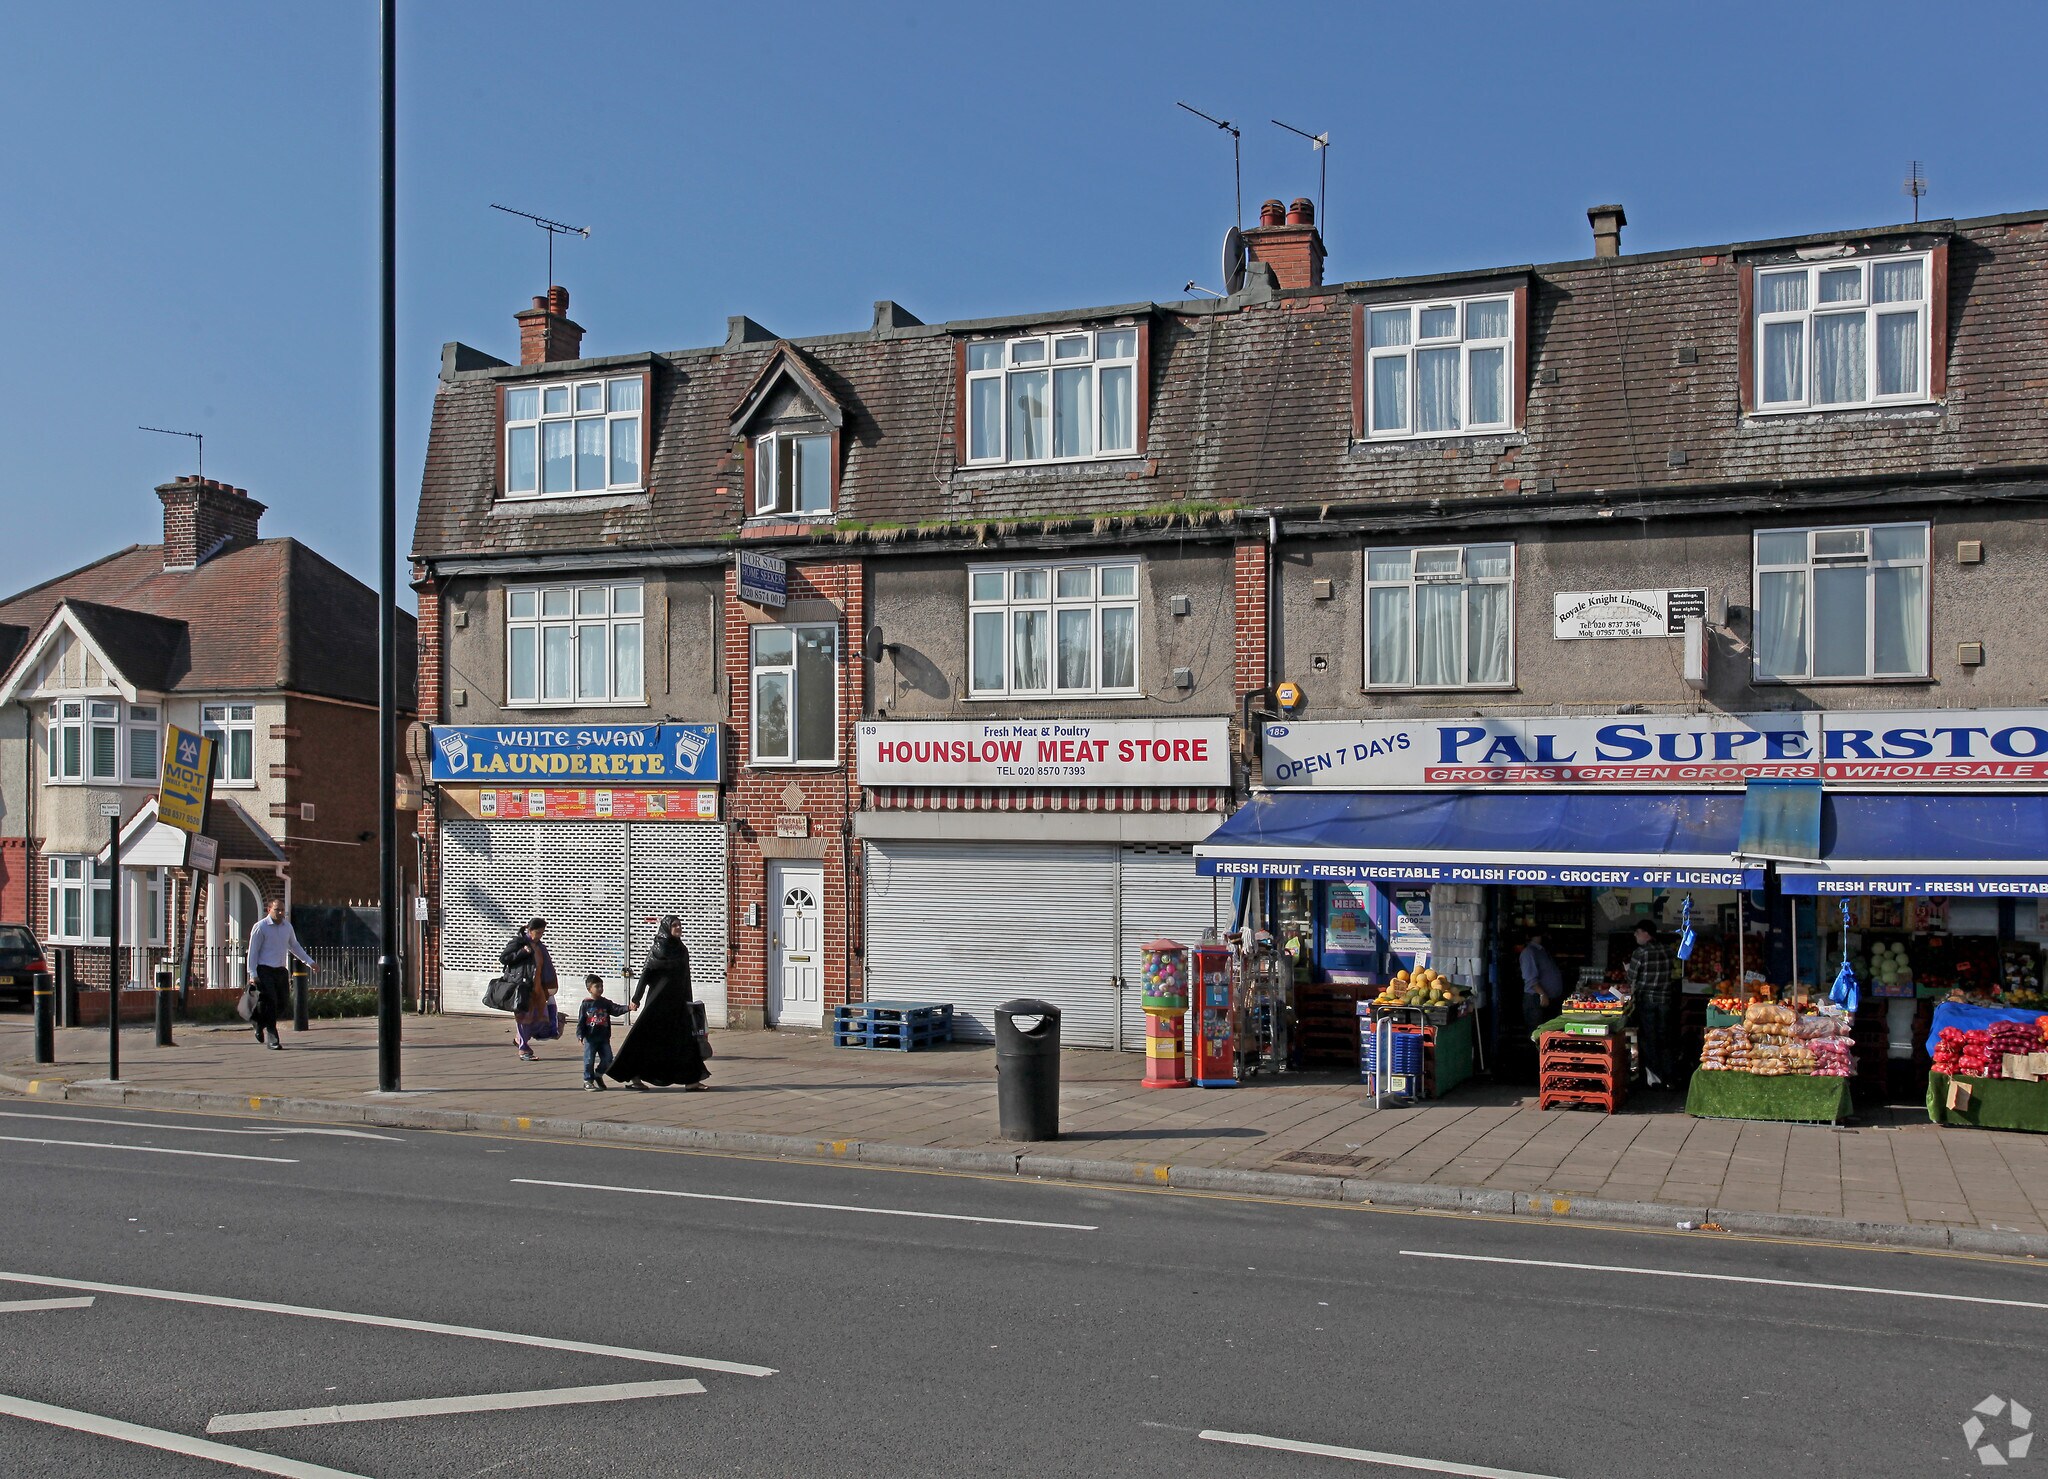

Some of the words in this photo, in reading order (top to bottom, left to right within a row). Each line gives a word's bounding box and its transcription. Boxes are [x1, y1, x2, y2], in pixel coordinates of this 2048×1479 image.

[743, 553, 761, 567] FOR
[762, 558, 785, 573] SALE
[742, 565, 760, 579] HOME
[761, 570, 786, 585] SEEKERS
[743, 587, 754, 597] 020
[754, 590, 770, 602] 8574
[770, 593, 786, 606] 0012
[1559, 602, 1587, 623] Royale
[1588, 594, 1618, 606] Knight
[1620, 595, 1663, 621] Limousine
[1280, 690, 1293, 699] ADT
[497, 731, 570, 746] WHITE
[576, 731, 645, 747] SWAN
[861, 727, 876, 735] 189
[984, 726, 1009, 737] Fresh
[1013, 726, 1037, 737] Meat
[1041, 727, 1050, 736] &
[1054, 725, 1090, 738] Poultry
[1269, 728, 1286, 736] 185
[878, 741, 1022, 763] HOUNSLOW
[1038, 740, 1109, 763] MEAT
[1118, 739, 1208, 762] STORE
[1436, 727, 1577, 763] PAL
[472, 753, 665, 774] LAUNDERETE
[1276, 752, 1332, 780] OPEN
[1336, 748, 1347, 765] 7
[1353, 732, 1411, 761] DAYS
[166, 763, 204, 785] MOT
[997, 767, 1015, 775] TEL
[1018, 767, 1035, 775] 020
[1037, 767, 1060, 775] 8570
[1063, 767, 1086, 775] 7393
[1431, 768, 1556, 781] GROCERS
[1578, 767, 1676, 780] GREEN
[1678, 766, 1816, 779] GROCERS
[1844, 764, 2035, 777] WHOLESALE
[1216, 863, 1258, 874] FRESH
[1262, 864, 1301, 875] FRUIT
[1312, 865, 1356, 877] FRESH
[1360, 866, 1440, 878] VEGETABLE
[1452, 868, 1503, 880] POLISH
[1508, 870, 1548, 881] FOOD
[1559, 870, 1631, 883] GROCERY
[1642, 871, 1672, 883] OFF
[1676, 872, 1742, 885] LICENCE
[1817, 881, 1864, 892] FRESH
[1868, 882, 1912, 892] FRUIT
[1925, 882, 1974, 893] FRESH
[1977, 882, 2048, 894] VEGETAB
[1334, 900, 1363, 909] HERE
